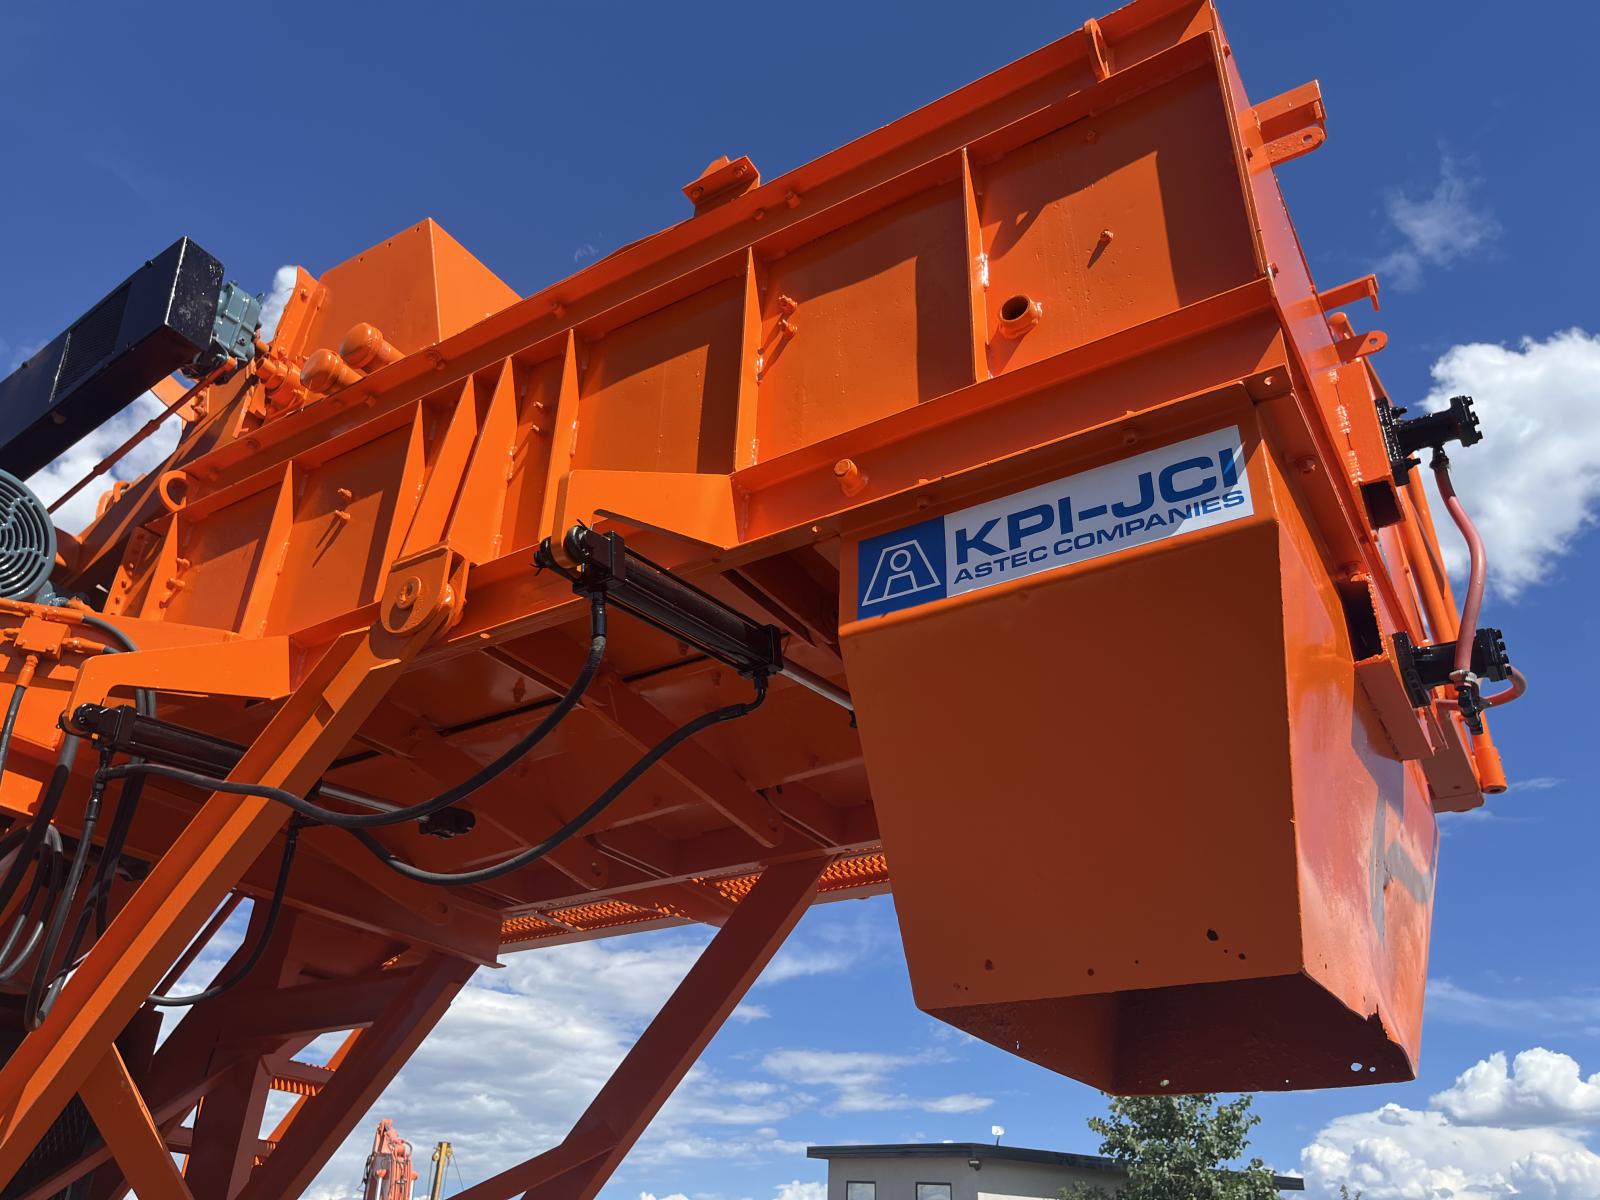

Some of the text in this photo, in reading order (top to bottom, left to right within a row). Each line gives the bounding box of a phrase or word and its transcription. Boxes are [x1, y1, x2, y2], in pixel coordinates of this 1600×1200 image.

[953, 489, 1245, 585] ASTEC COMPANIES
[955, 447, 1239, 565] KPI-JCI
